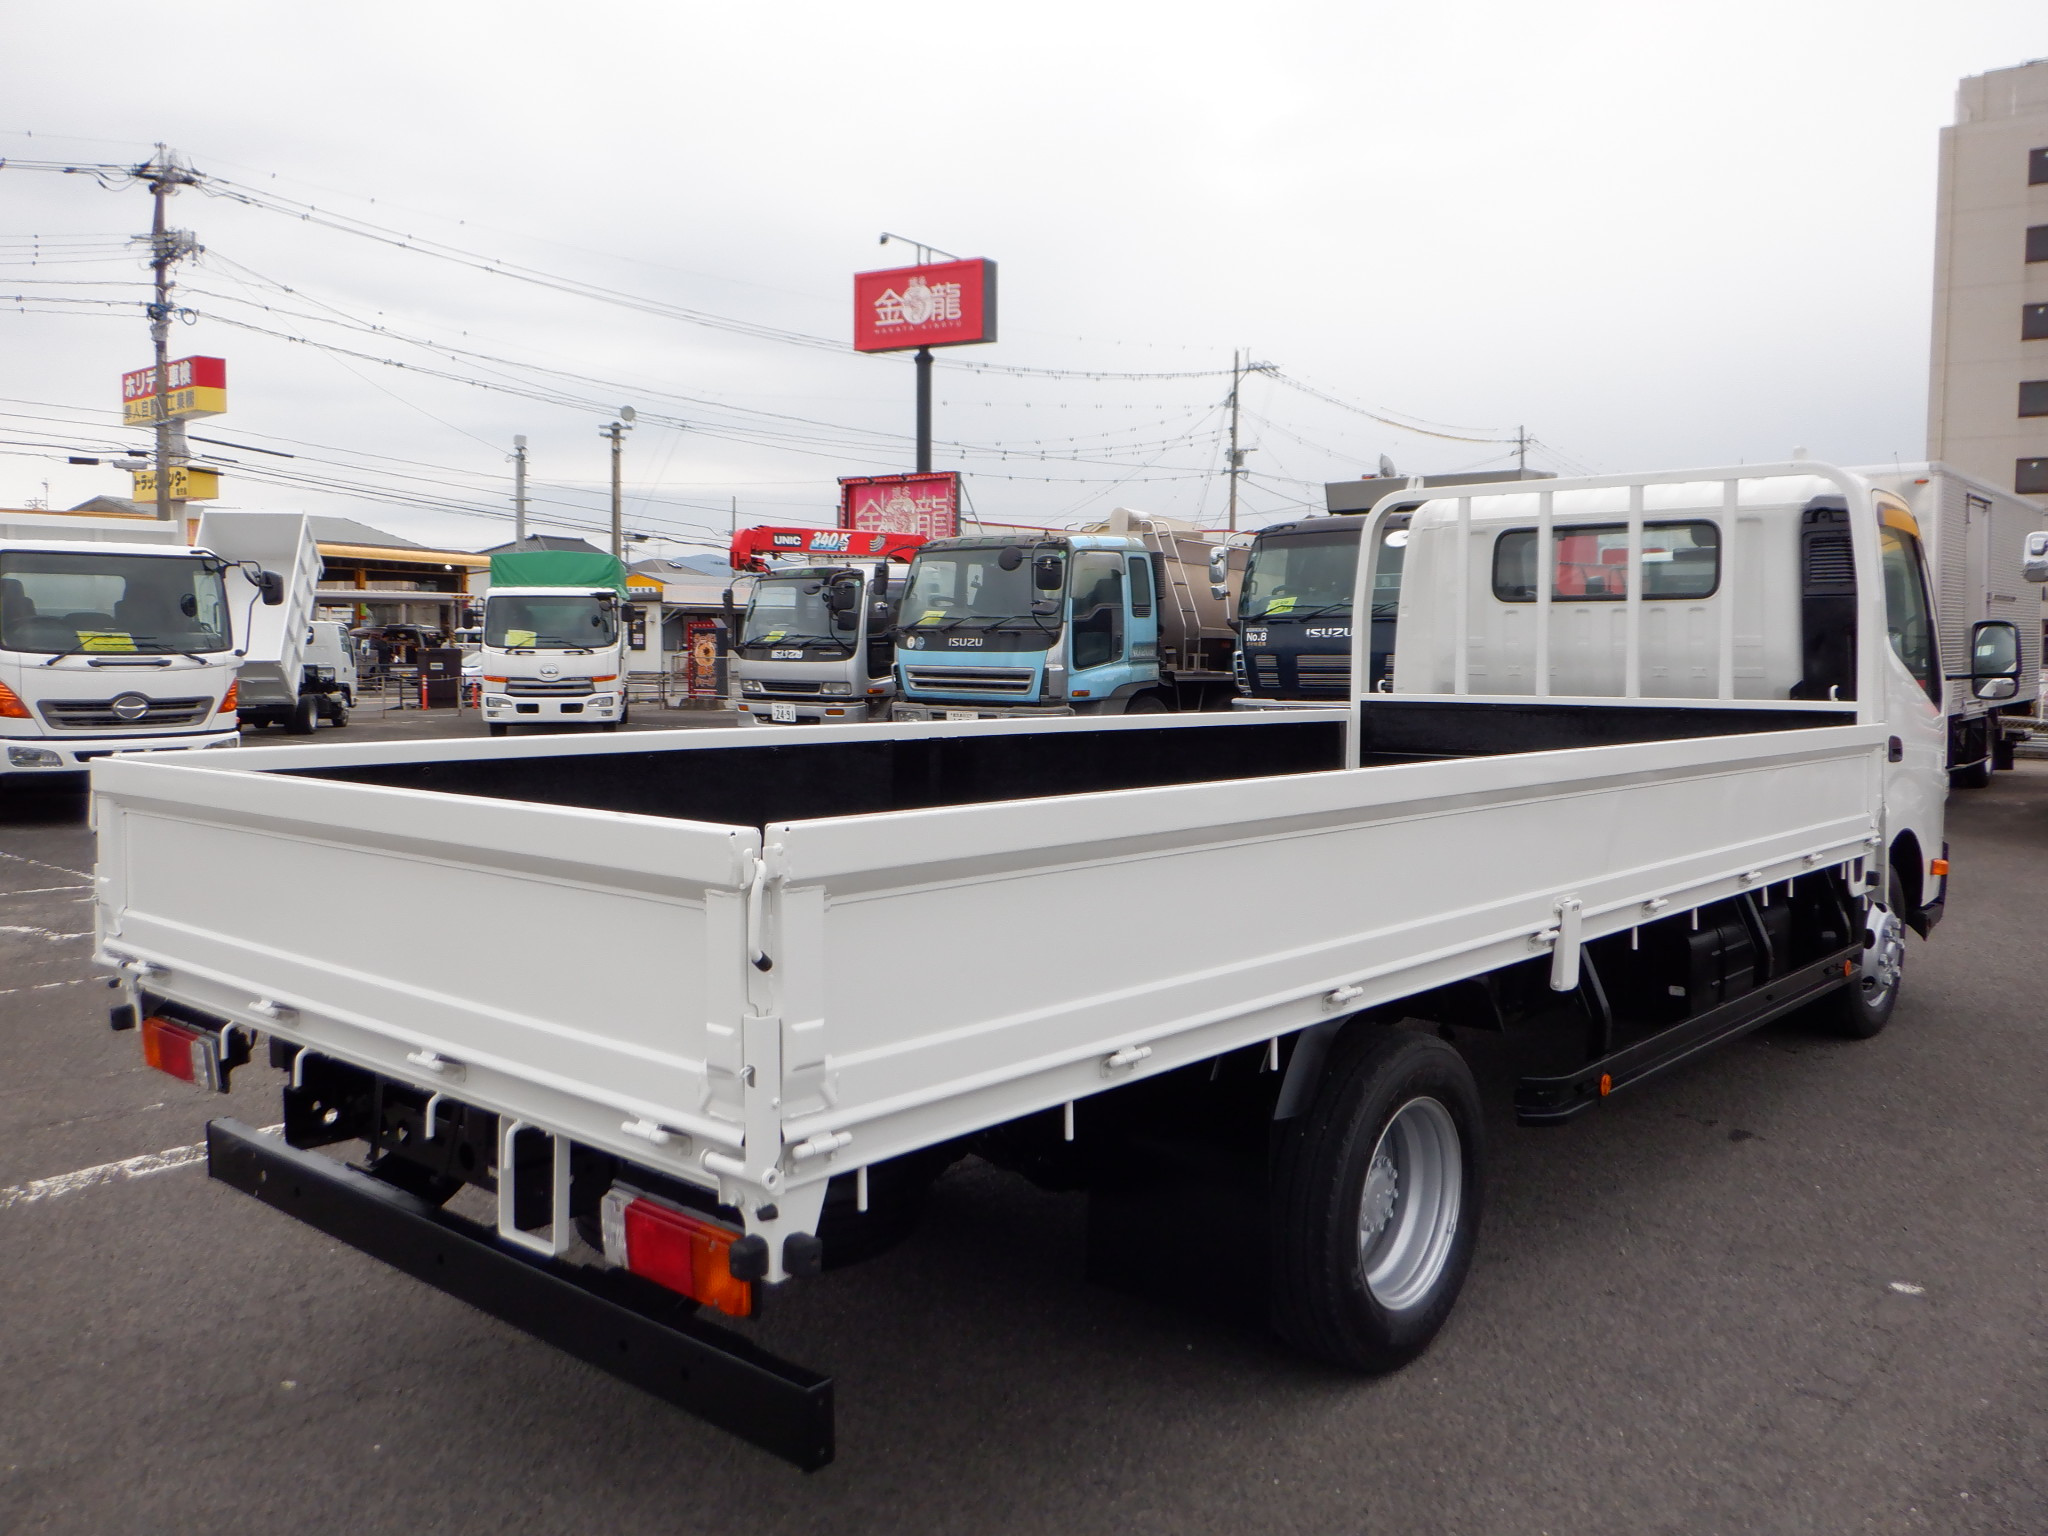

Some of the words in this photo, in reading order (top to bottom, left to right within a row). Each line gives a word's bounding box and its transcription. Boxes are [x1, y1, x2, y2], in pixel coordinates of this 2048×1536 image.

[124, 360, 192, 398] ホリデ車検
[773, 535, 802, 546] UNIC
[1246, 632, 1267, 642] No.8
[948, 638, 983, 647] ISUZU
